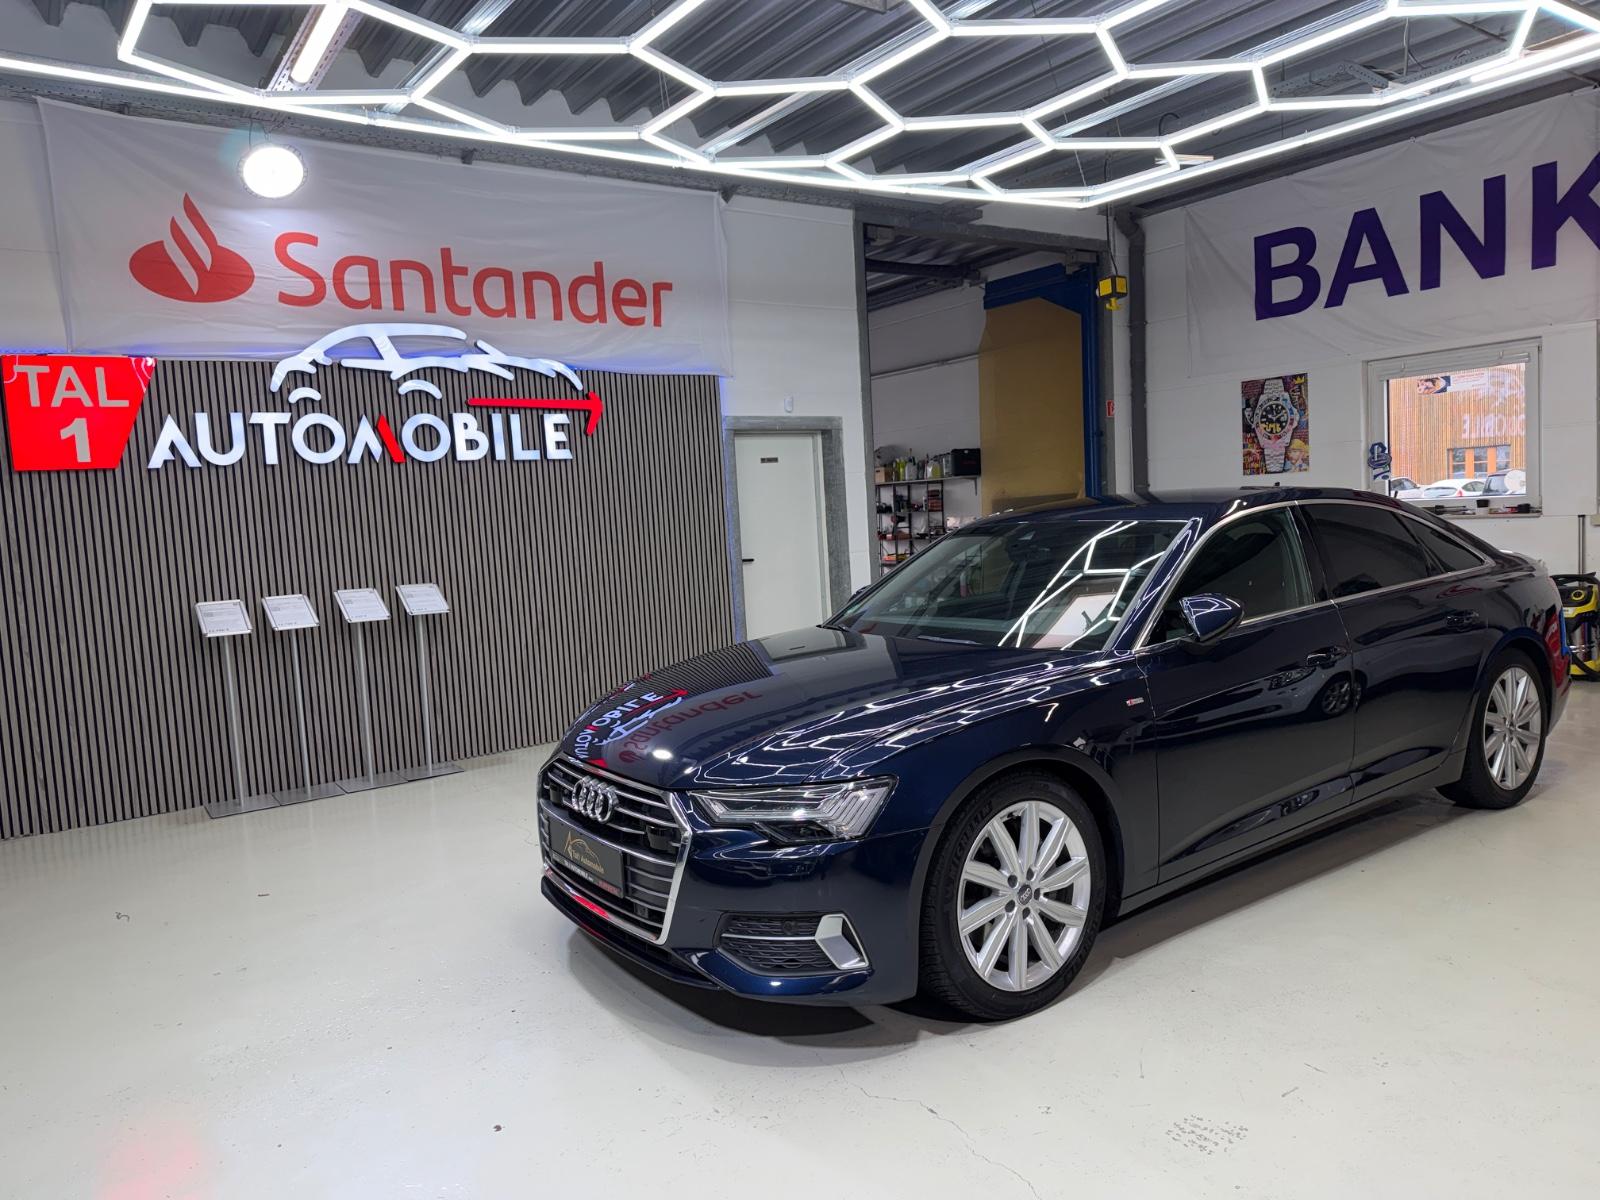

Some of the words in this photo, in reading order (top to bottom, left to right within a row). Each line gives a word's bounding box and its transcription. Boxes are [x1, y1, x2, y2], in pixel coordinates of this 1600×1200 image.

[1254, 152, 1600, 321] BANK
[274, 231, 673, 327] Santander
[13, 365, 130, 407] TAL
[60, 418, 91, 462] 1
[147, 412, 573, 468] AUTOMOBILE
